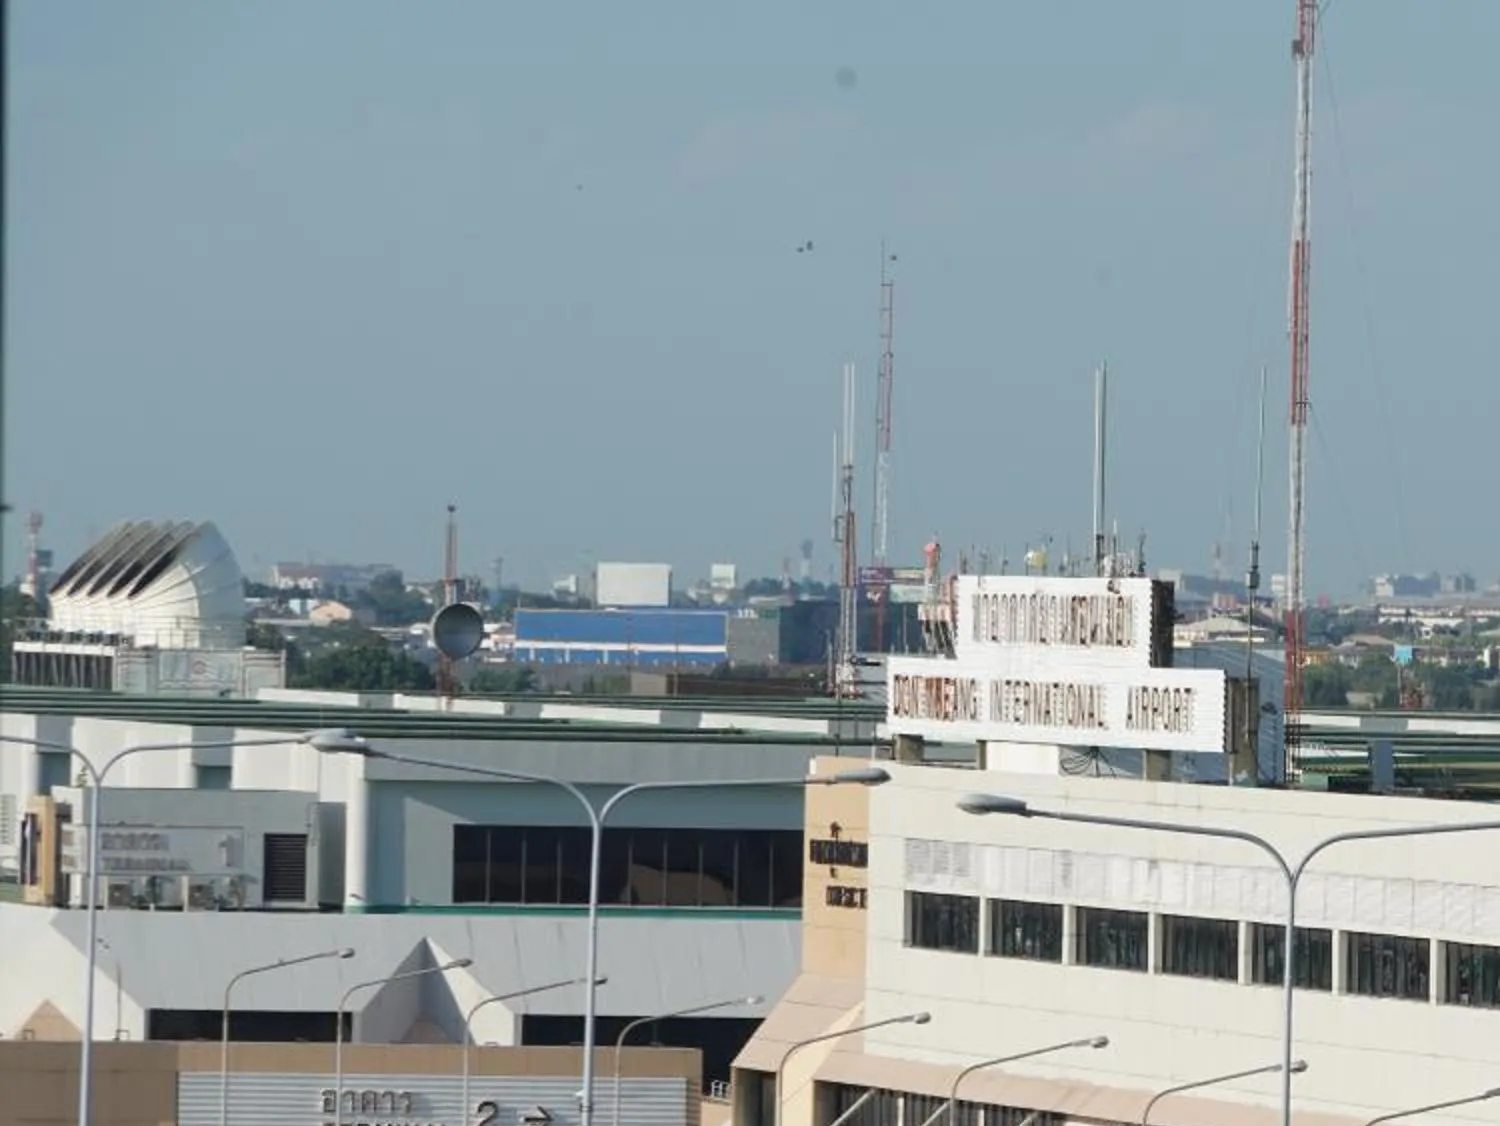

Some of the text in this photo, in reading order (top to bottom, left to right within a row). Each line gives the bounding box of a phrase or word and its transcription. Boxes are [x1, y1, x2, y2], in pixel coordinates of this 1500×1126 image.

[990, 679, 1109, 730] INTERNATIONAL
[1126, 685, 1195, 733] AIRPORT
[321, 1088, 414, 1115] อาคาร
